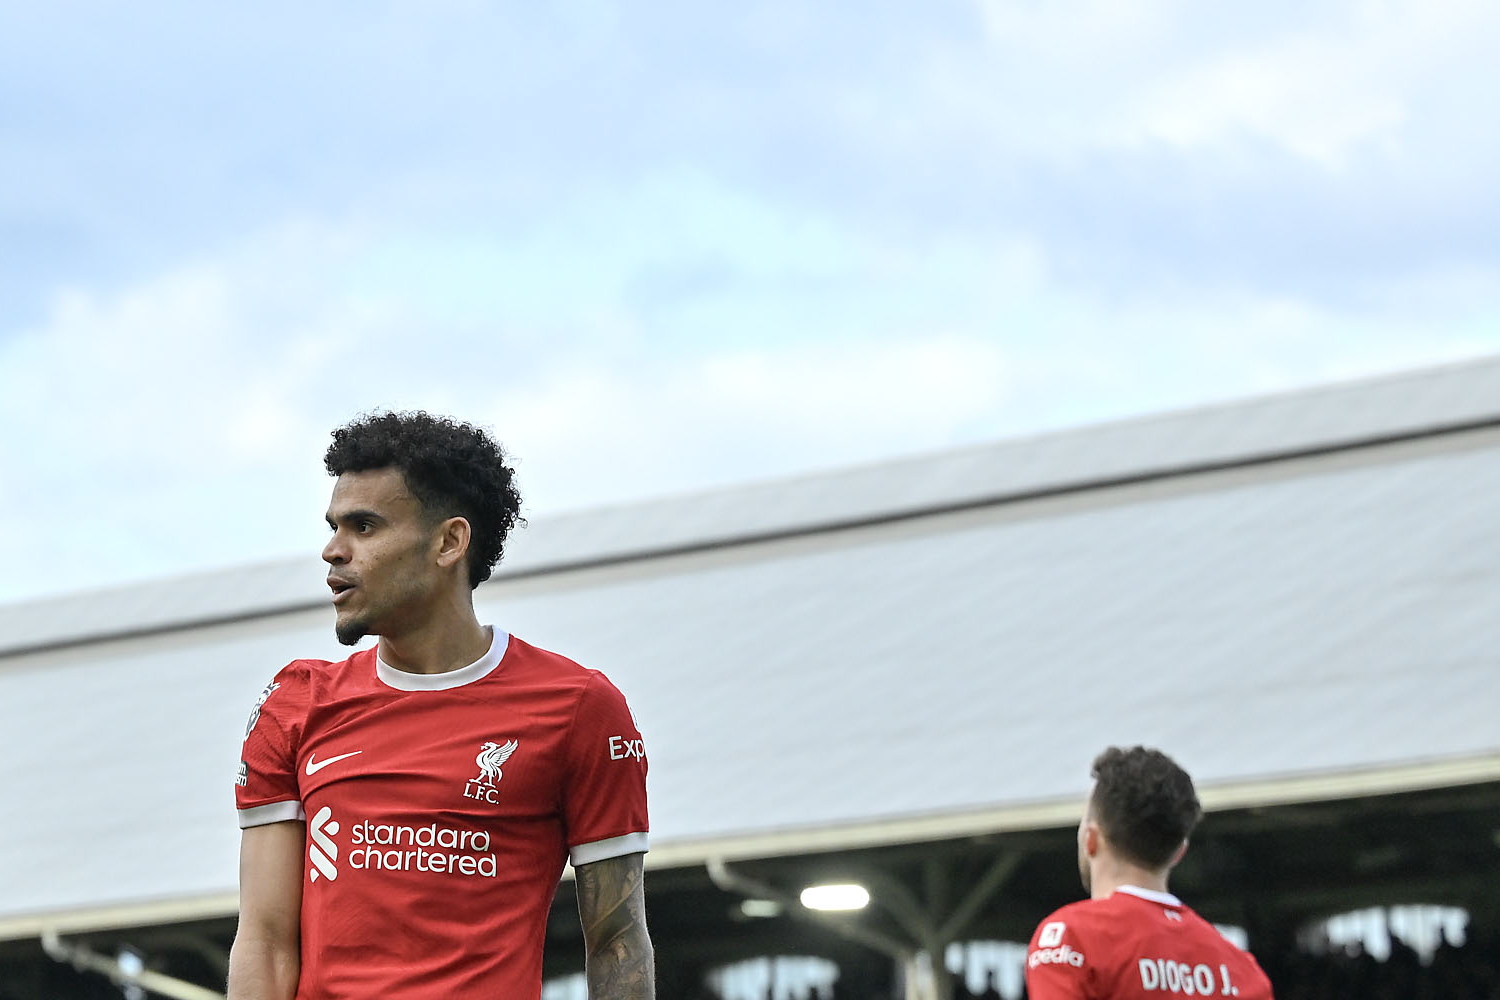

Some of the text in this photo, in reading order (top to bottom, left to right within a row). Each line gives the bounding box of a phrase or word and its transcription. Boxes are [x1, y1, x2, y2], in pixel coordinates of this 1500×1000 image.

[463, 782, 499, 804] L.F.C.
[351, 820, 490, 852] standard
[349, 846, 497, 877] chartered
[1138, 958, 1240, 996] DIOGO J.
